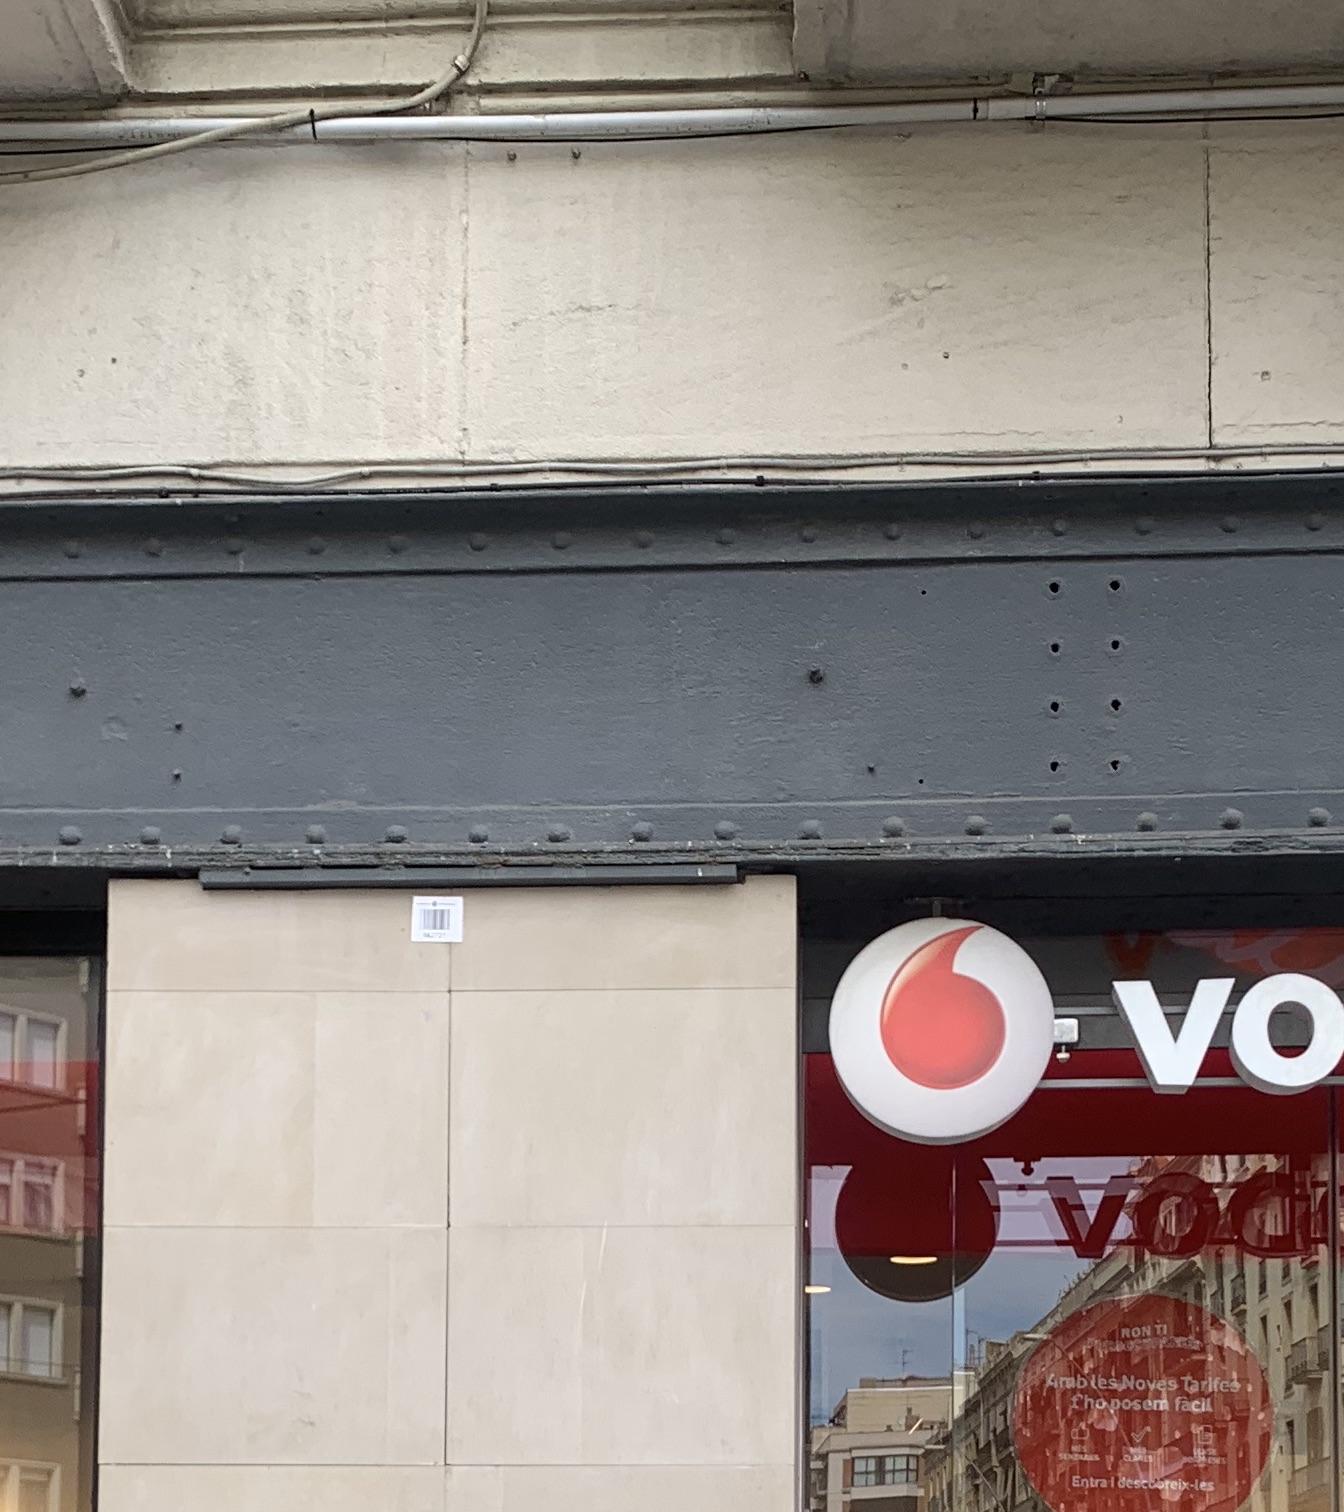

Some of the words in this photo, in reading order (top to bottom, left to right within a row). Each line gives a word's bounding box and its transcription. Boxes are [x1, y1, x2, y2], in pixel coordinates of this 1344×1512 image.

[1046, 1374, 1088, 1389] Amb
[1090, 1374, 1117, 1389] les
[1122, 1375, 1177, 1392] Noves
[1181, 1375, 1241, 1393] Tarifes
[1072, 1476, 1107, 1489] Entra
